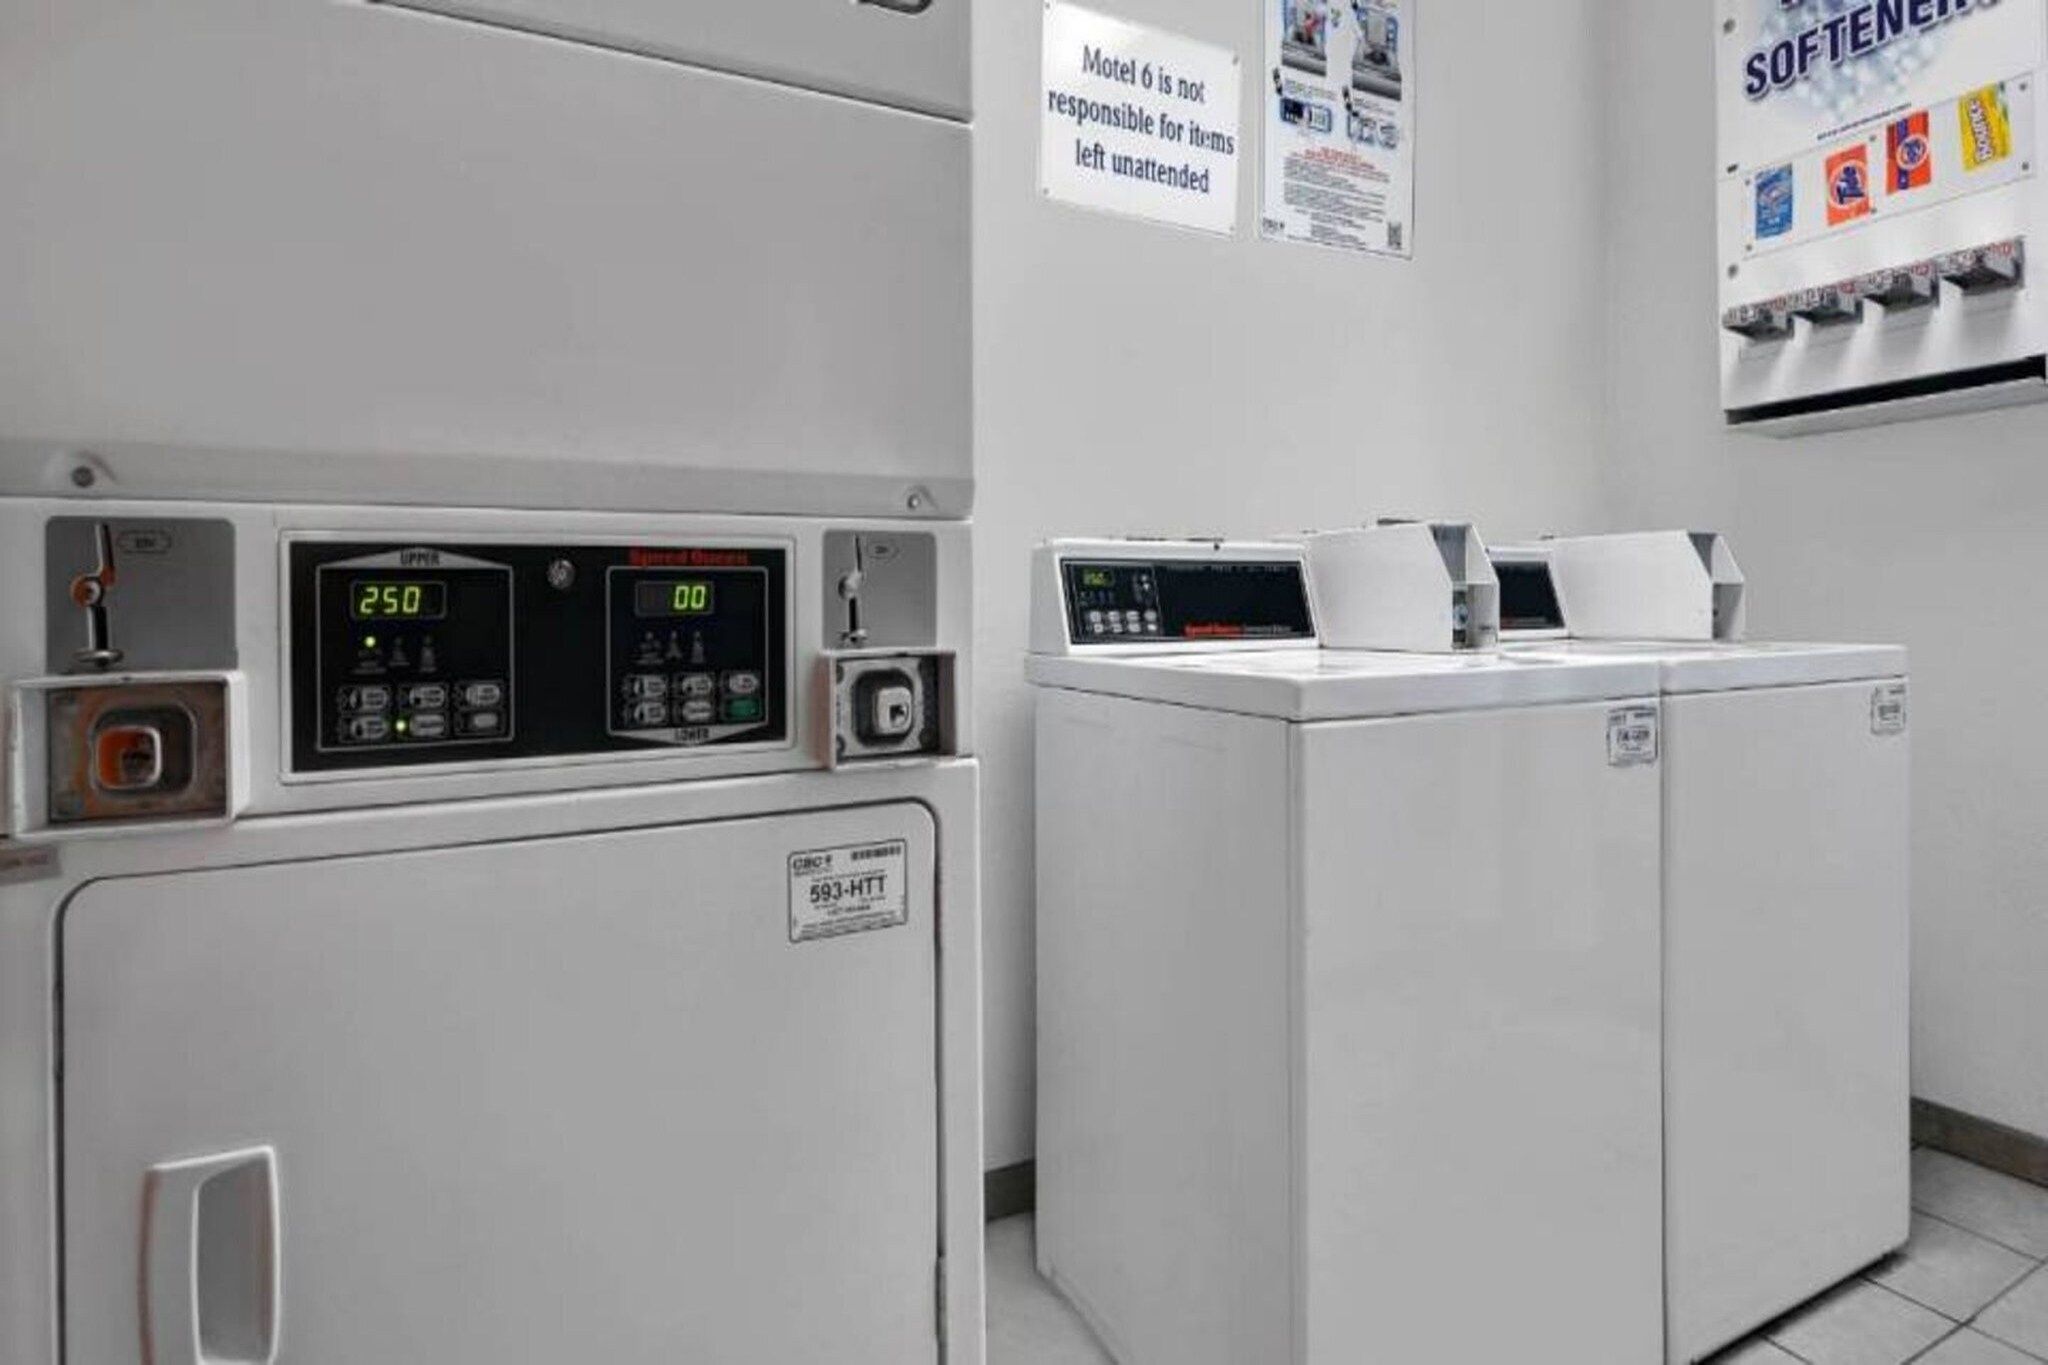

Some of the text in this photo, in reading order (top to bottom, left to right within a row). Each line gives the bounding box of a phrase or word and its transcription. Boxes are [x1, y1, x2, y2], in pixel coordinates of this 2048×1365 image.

[1083, 44, 1205, 103] Motel 6 is not
[1048, 90, 1234, 155] responsible for items
[1075, 138, 1210, 194] left unattended
[400, 552, 440, 566] UPPER
[360, 586, 421, 614] 250
[674, 585, 705, 610] 00
[675, 728, 709, 741] LOWER
[810, 874, 887, 903] 593-HTT
